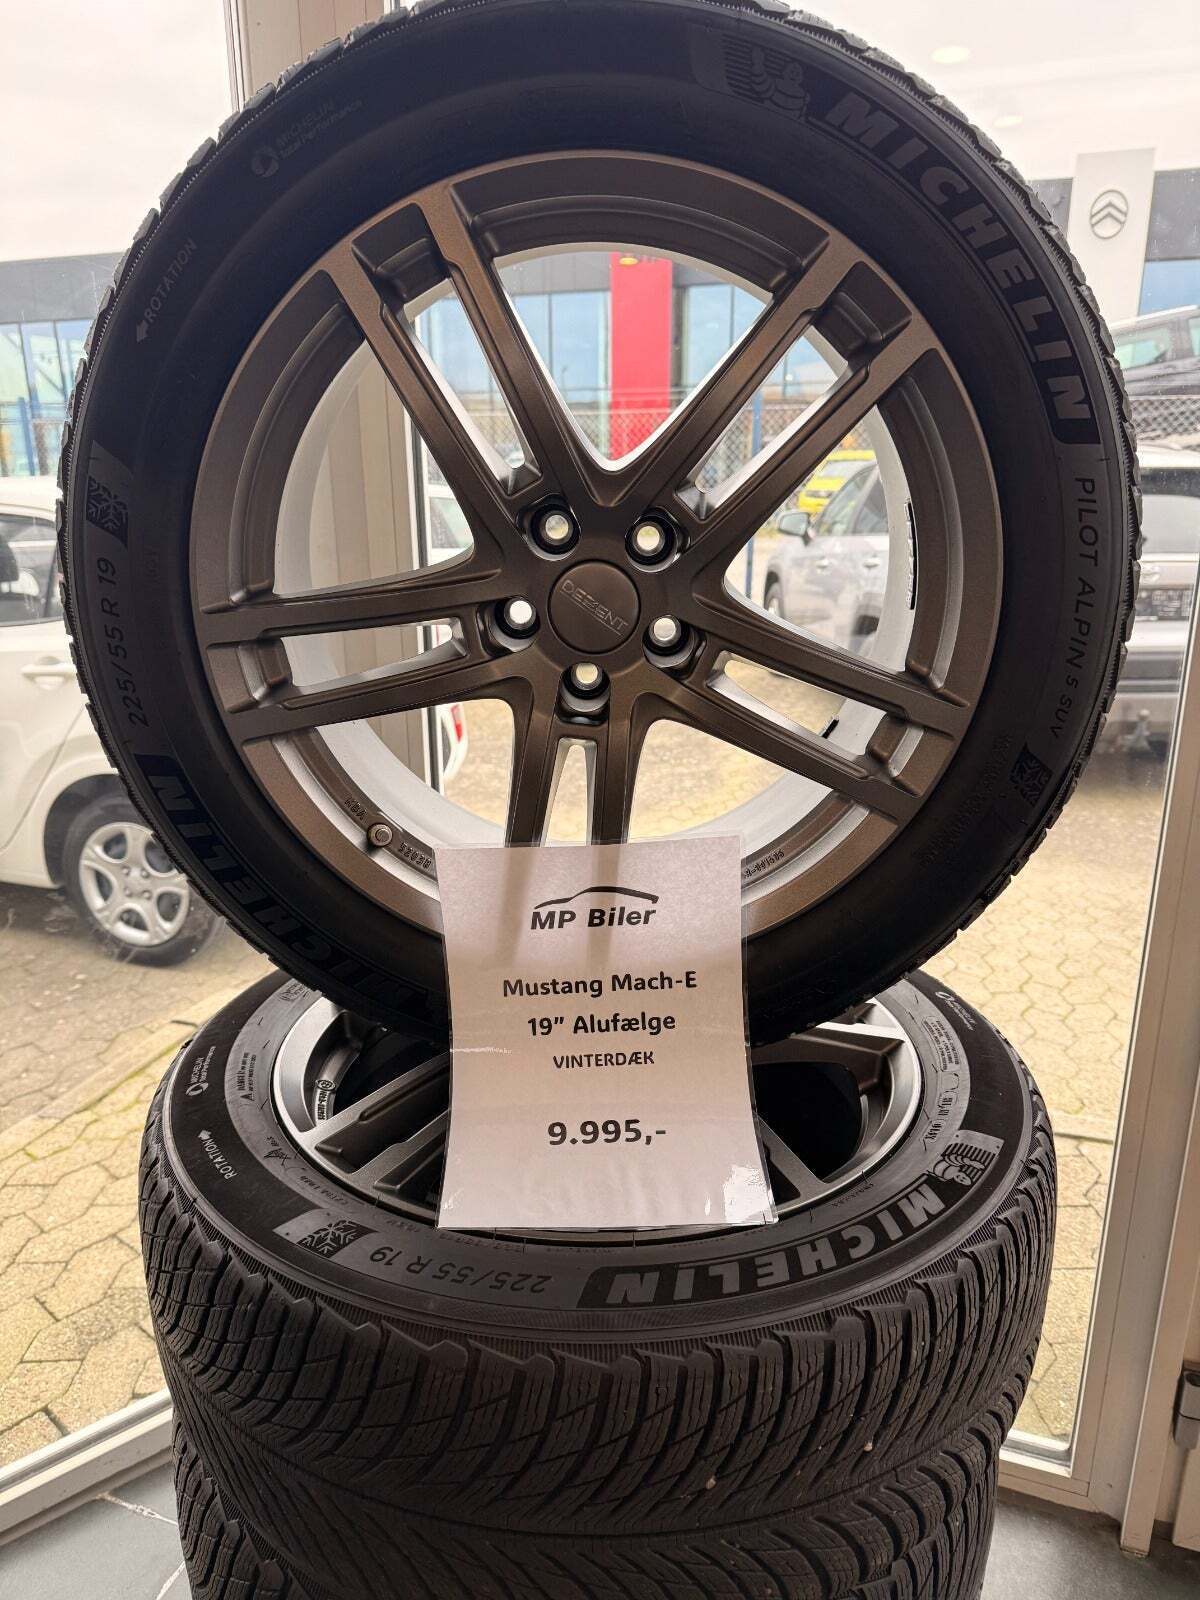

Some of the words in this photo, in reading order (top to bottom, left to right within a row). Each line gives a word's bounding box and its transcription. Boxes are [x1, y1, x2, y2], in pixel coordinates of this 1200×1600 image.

[825, 92, 1091, 419] MICHELIN
[144, 237, 198, 323] ROTATION
[1075, 477, 1098, 566] PILOT
[96, 557, 116, 586] 19
[101, 597, 120, 618] R
[561, 579, 629, 631] DEZENT
[1065, 576, 1096, 669] ALPIN
[104, 624, 149, 727] 225/55
[1065, 674, 1079, 688] 5
[1050, 694, 1072, 738] SUV
[147, 775, 418, 1012] MICHELIN
[531, 910, 576, 930] MP
[588, 907, 656, 927] Biler
[503, 978, 603, 998] Mustang
[611, 971, 698, 991] Mach-E
[573, 1012, 676, 1035] Alufælge
[553, 1051, 655, 1069] VINTERDÆK
[547, 1118, 667, 1146] 9.995,-
[202, 1137, 239, 1180] ROTATION
[369, 1246, 402, 1266] 19
[606, 1184, 946, 1304] MICHELIN
[406, 1255, 432, 1275] R
[432, 1262, 552, 1293] 225/55
